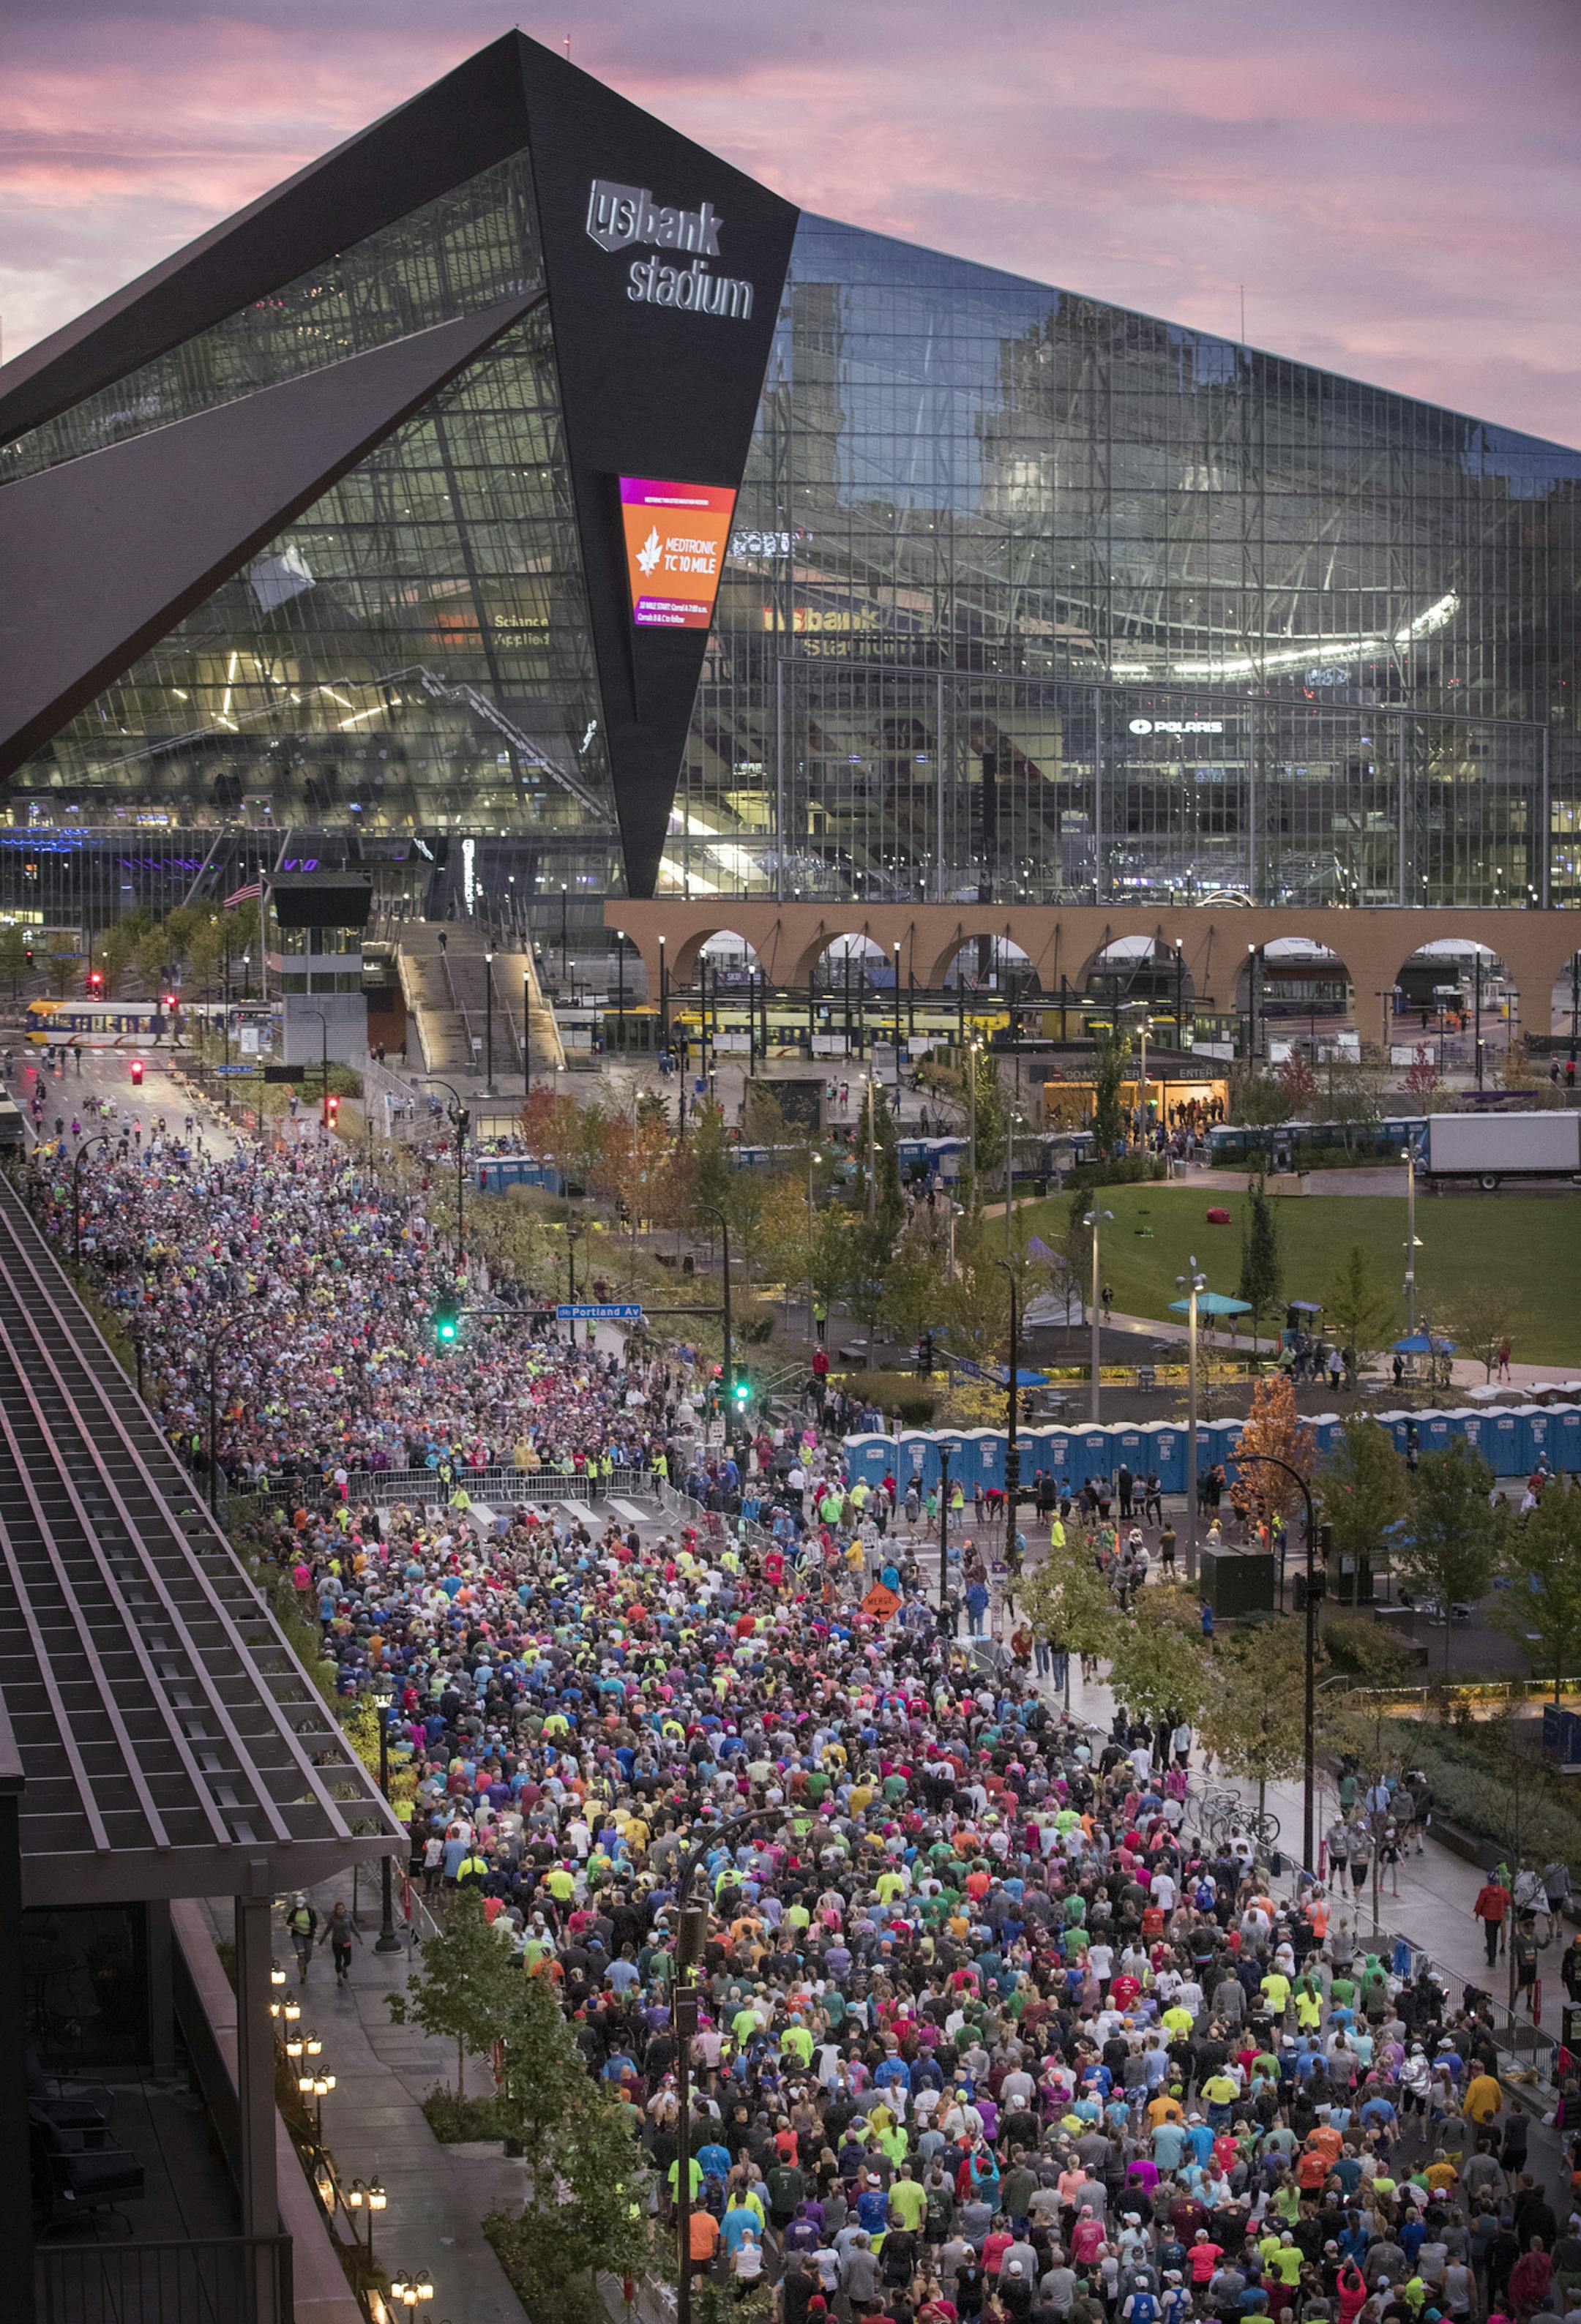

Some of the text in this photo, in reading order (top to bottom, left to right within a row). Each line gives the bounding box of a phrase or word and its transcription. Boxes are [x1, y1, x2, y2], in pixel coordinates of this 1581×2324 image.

[627, 255, 755, 320] stadium
[665, 537, 717, 555] MEDTRONIC
[665, 555, 717, 574] TC 10 MILE
[494, 615, 549, 628] Science
[1154, 721, 1222, 732] POLARIS
[1180, 1068, 1214, 1078] ENTER
[572, 1307, 639, 1316] Portland Av
[867, 1597, 892, 1605] MERGE
